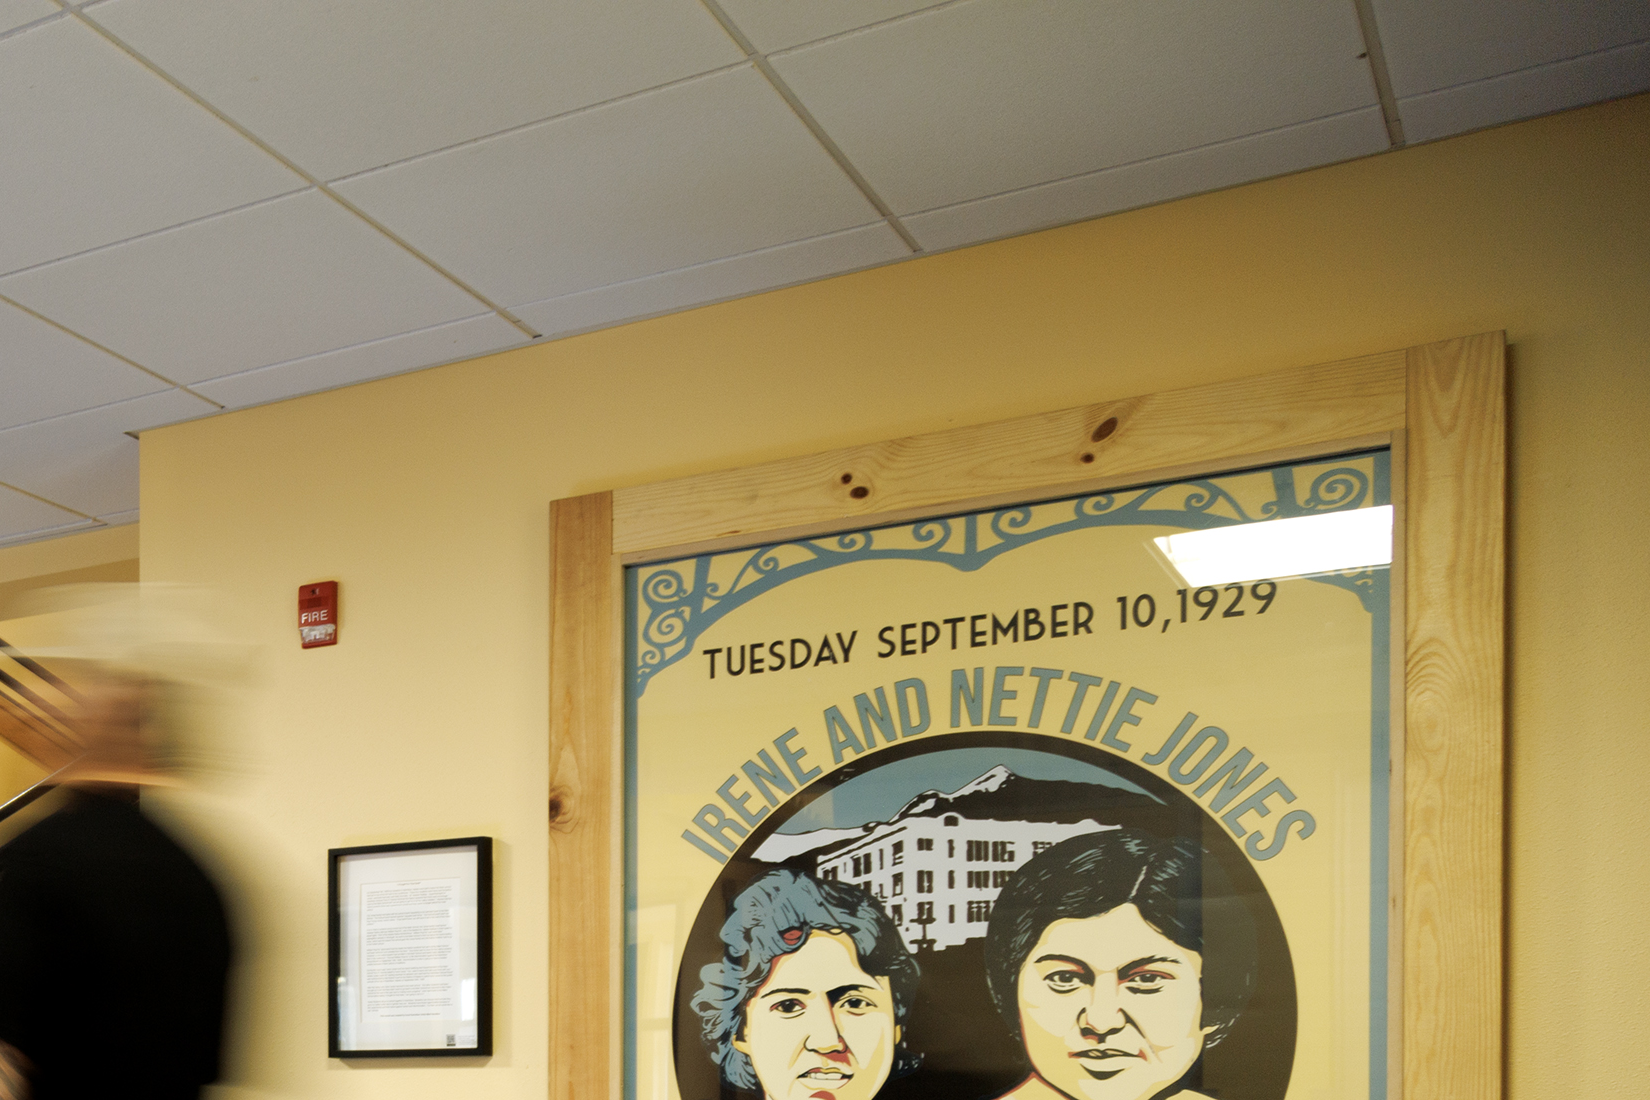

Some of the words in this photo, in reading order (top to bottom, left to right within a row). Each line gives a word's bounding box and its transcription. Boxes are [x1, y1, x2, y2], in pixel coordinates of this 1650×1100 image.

[301, 609, 329, 624] FIRE
[702, 629, 858, 680] TUESDAY
[877, 601, 1094, 659] SEPTEMBER
[681, 727, 824, 866] IRENE
[823, 677, 933, 765] AND
[949, 665, 1159, 753] NETTIE
[1140, 711, 1317, 861] JONES
